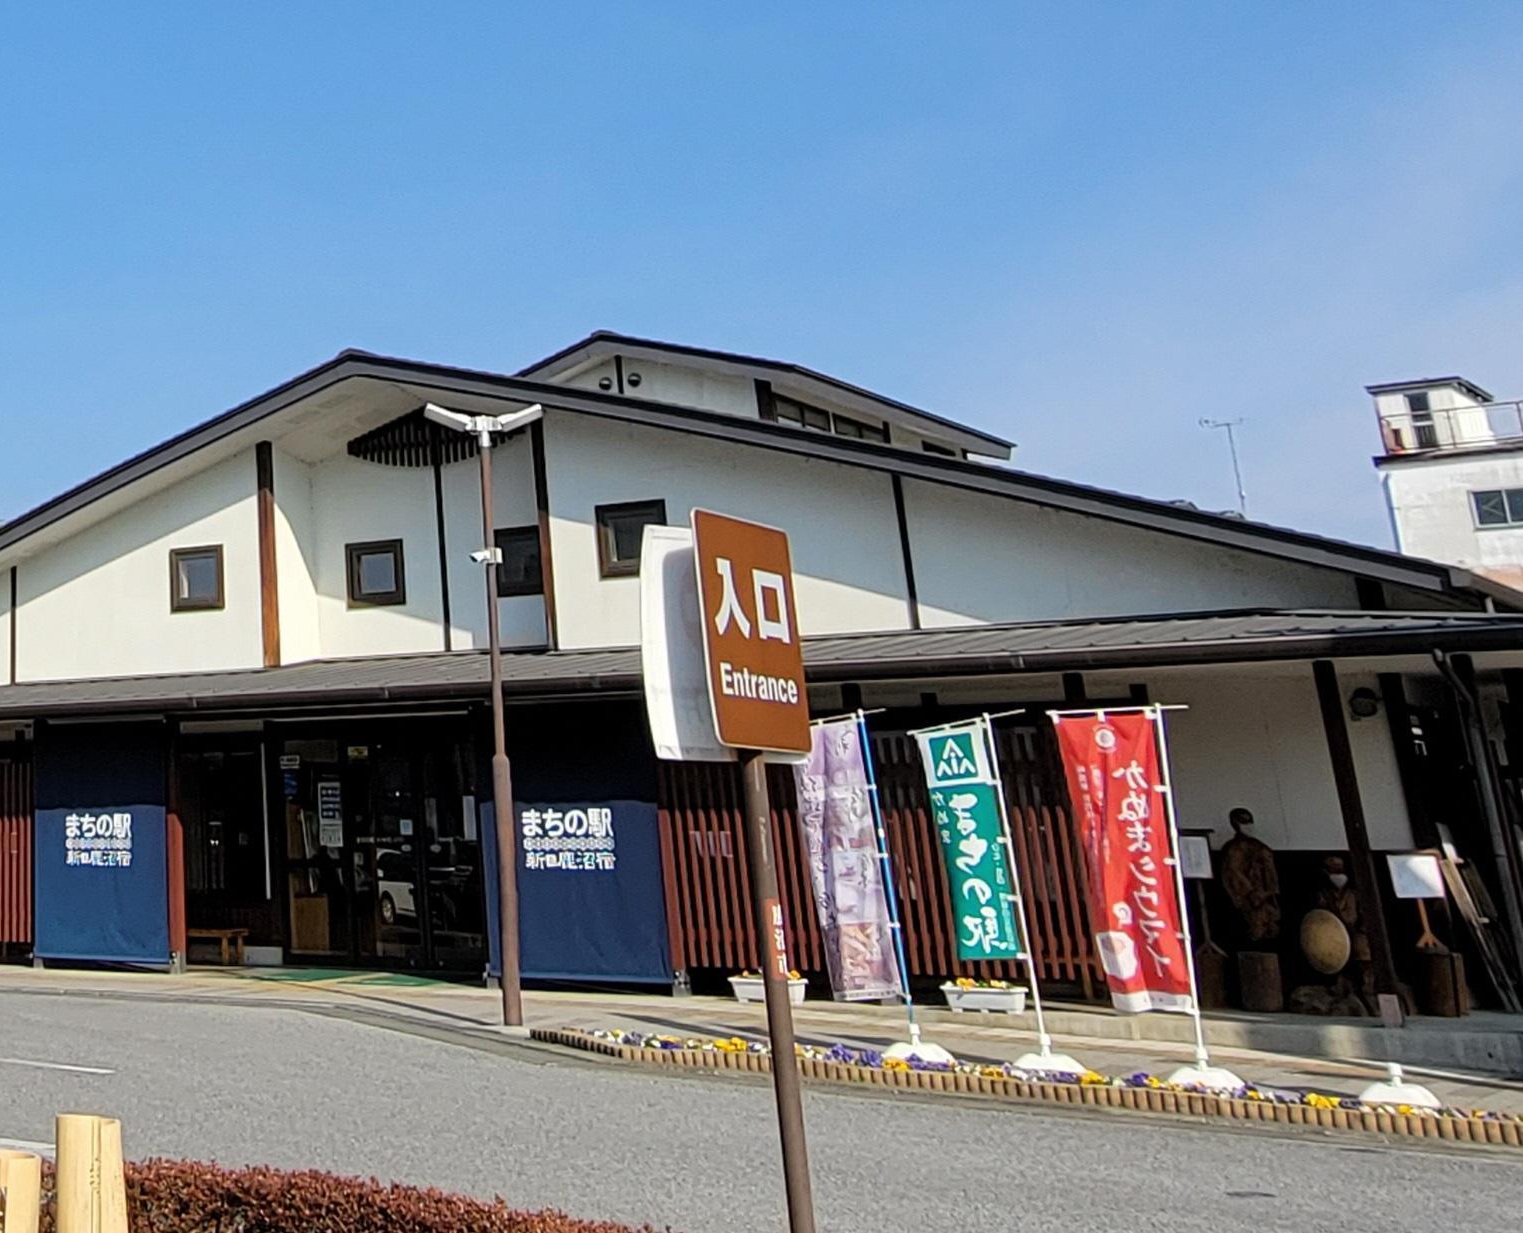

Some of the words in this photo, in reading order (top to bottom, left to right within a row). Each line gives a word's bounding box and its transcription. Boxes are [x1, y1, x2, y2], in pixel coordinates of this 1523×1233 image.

[715, 557, 791, 644] 入口
[719, 661, 798, 704] Entrance
[65, 812, 132, 838] まちの駅
[521, 808, 614, 837] まちの駅
